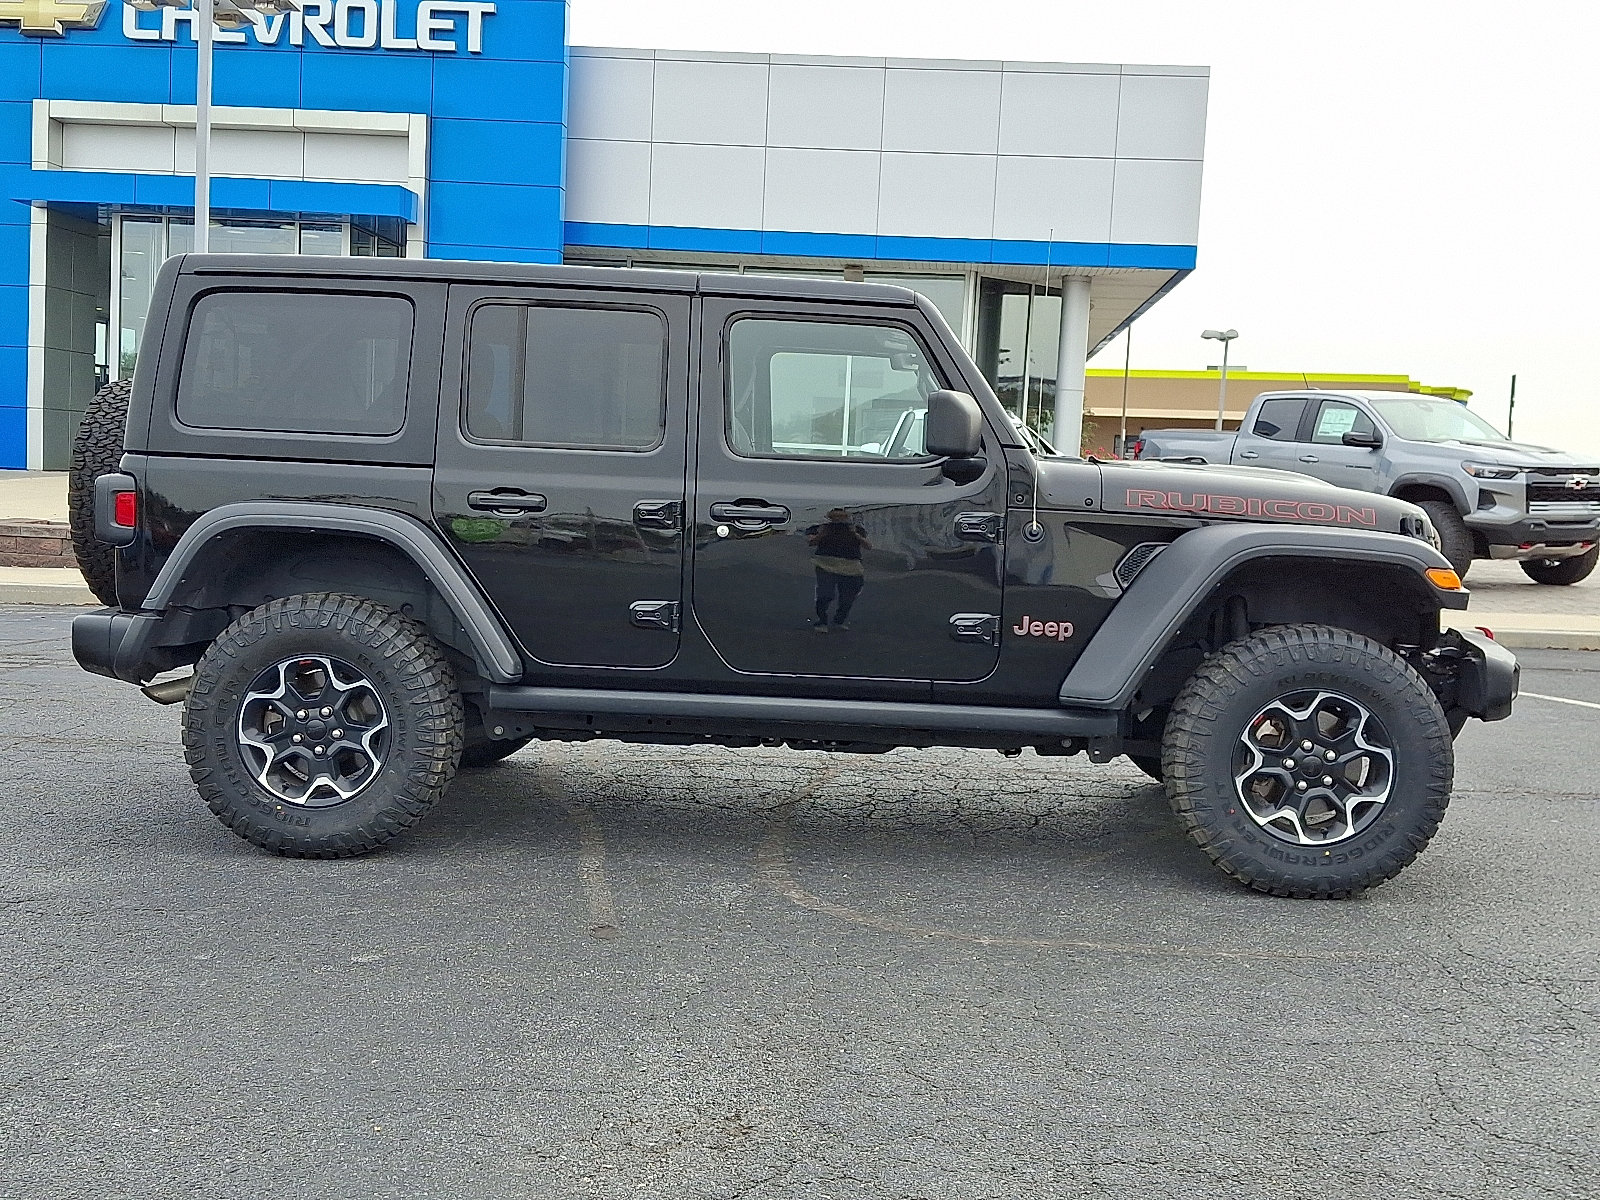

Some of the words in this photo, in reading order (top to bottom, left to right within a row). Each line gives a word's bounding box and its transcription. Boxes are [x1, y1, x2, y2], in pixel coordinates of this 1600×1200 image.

[1126, 489, 1376, 526] RUBICON
[1013, 615, 1074, 642] Jeep
[358, 653, 405, 759] BLACKHAWK
[1231, 820, 1394, 866] RIDGECRAWLER
